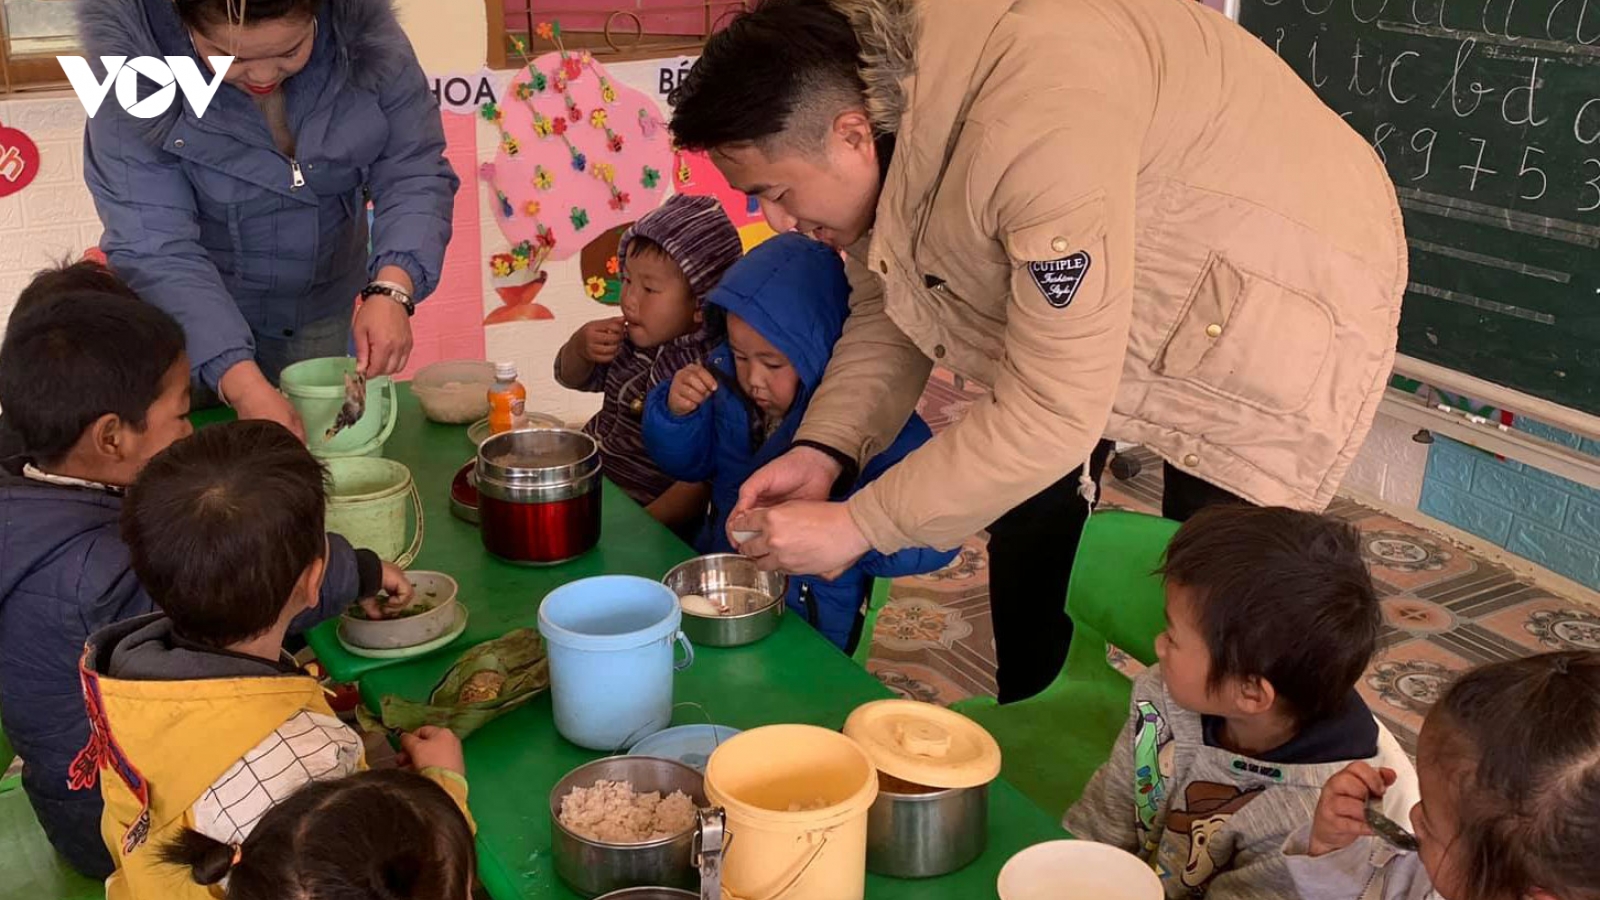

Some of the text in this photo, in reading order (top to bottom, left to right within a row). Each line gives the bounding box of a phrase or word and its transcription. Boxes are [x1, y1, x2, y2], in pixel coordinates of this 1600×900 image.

[1502, 56, 1548, 126] d
[1410, 127, 1437, 181] 9
[1459, 138, 1497, 191] 7
[1518, 146, 1547, 200] 5
[1577, 158, 1600, 210] 3
